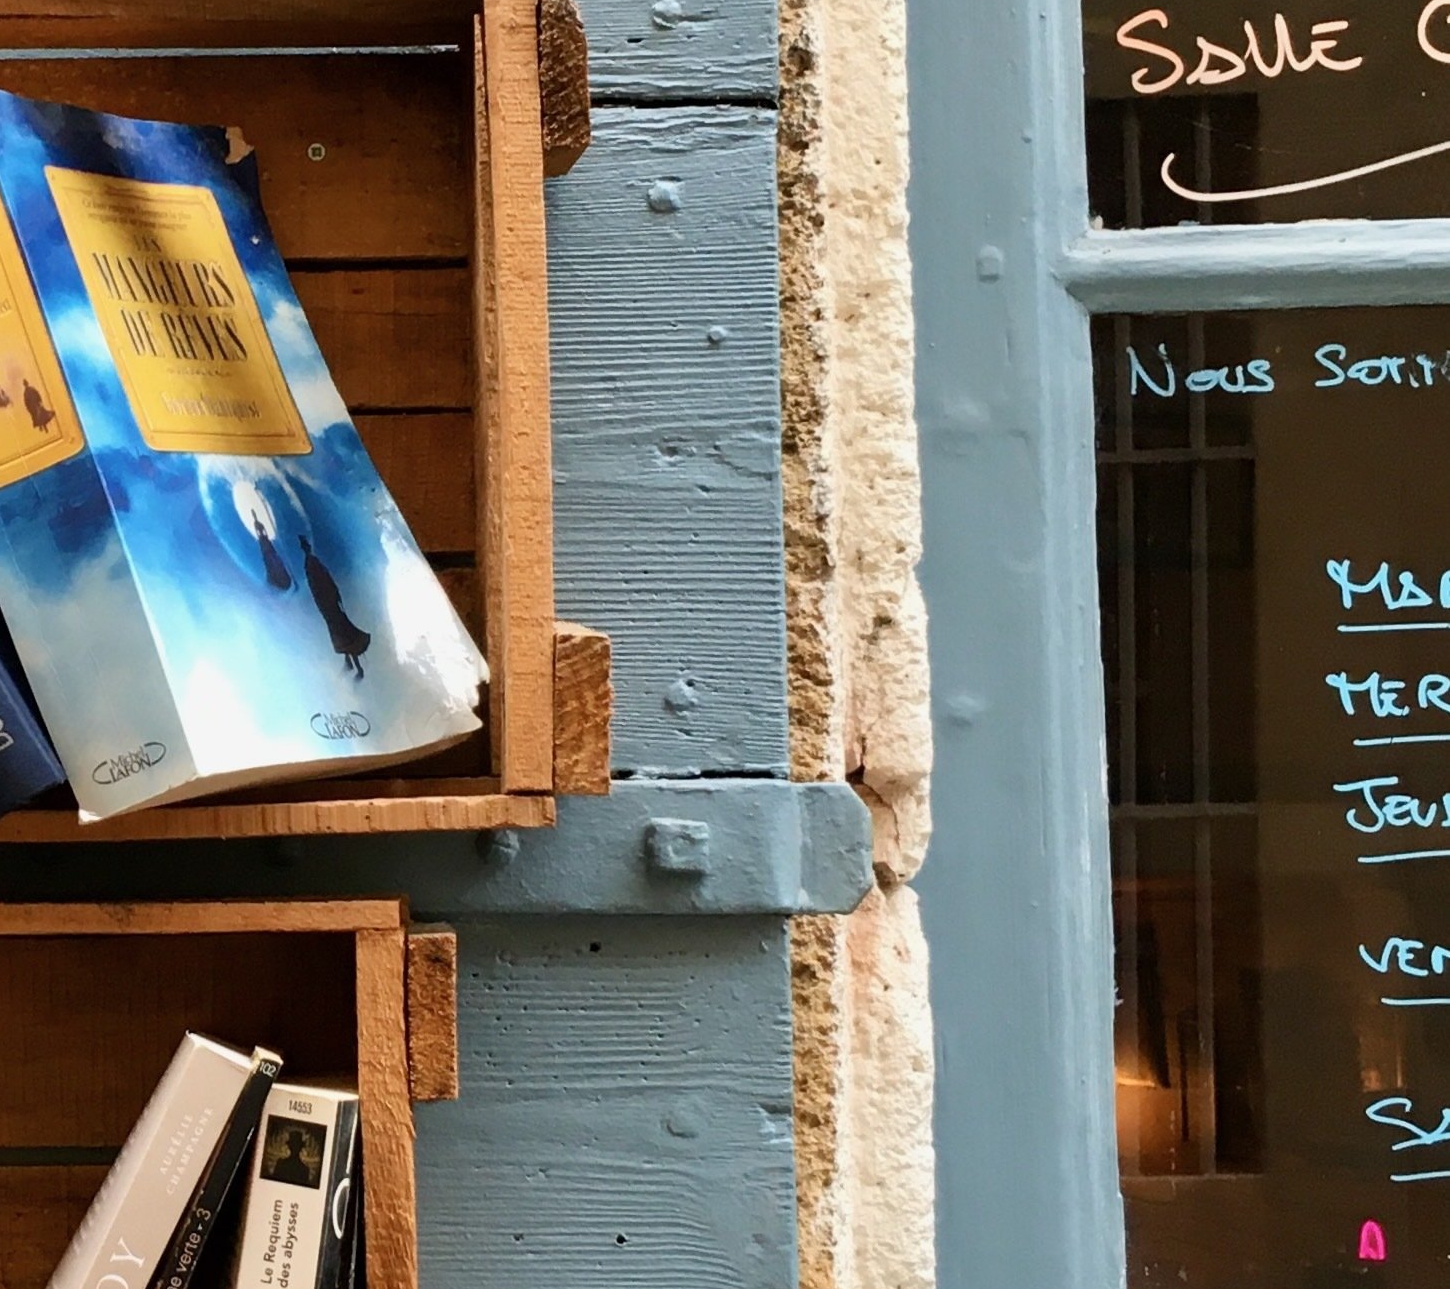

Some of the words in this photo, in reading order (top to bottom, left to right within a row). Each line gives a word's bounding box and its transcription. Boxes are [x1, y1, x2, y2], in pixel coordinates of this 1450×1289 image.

[258, 1061, 277, 1077] 102
[176, 1232, 201, 1272] verte
[196, 1208, 211, 1221] 3
[264, 1199, 284, 1262] Requiem
[279, 1258, 291, 1288] des
[285, 1202, 299, 1257] abysses
[260, 1268, 273, 1285] Le
